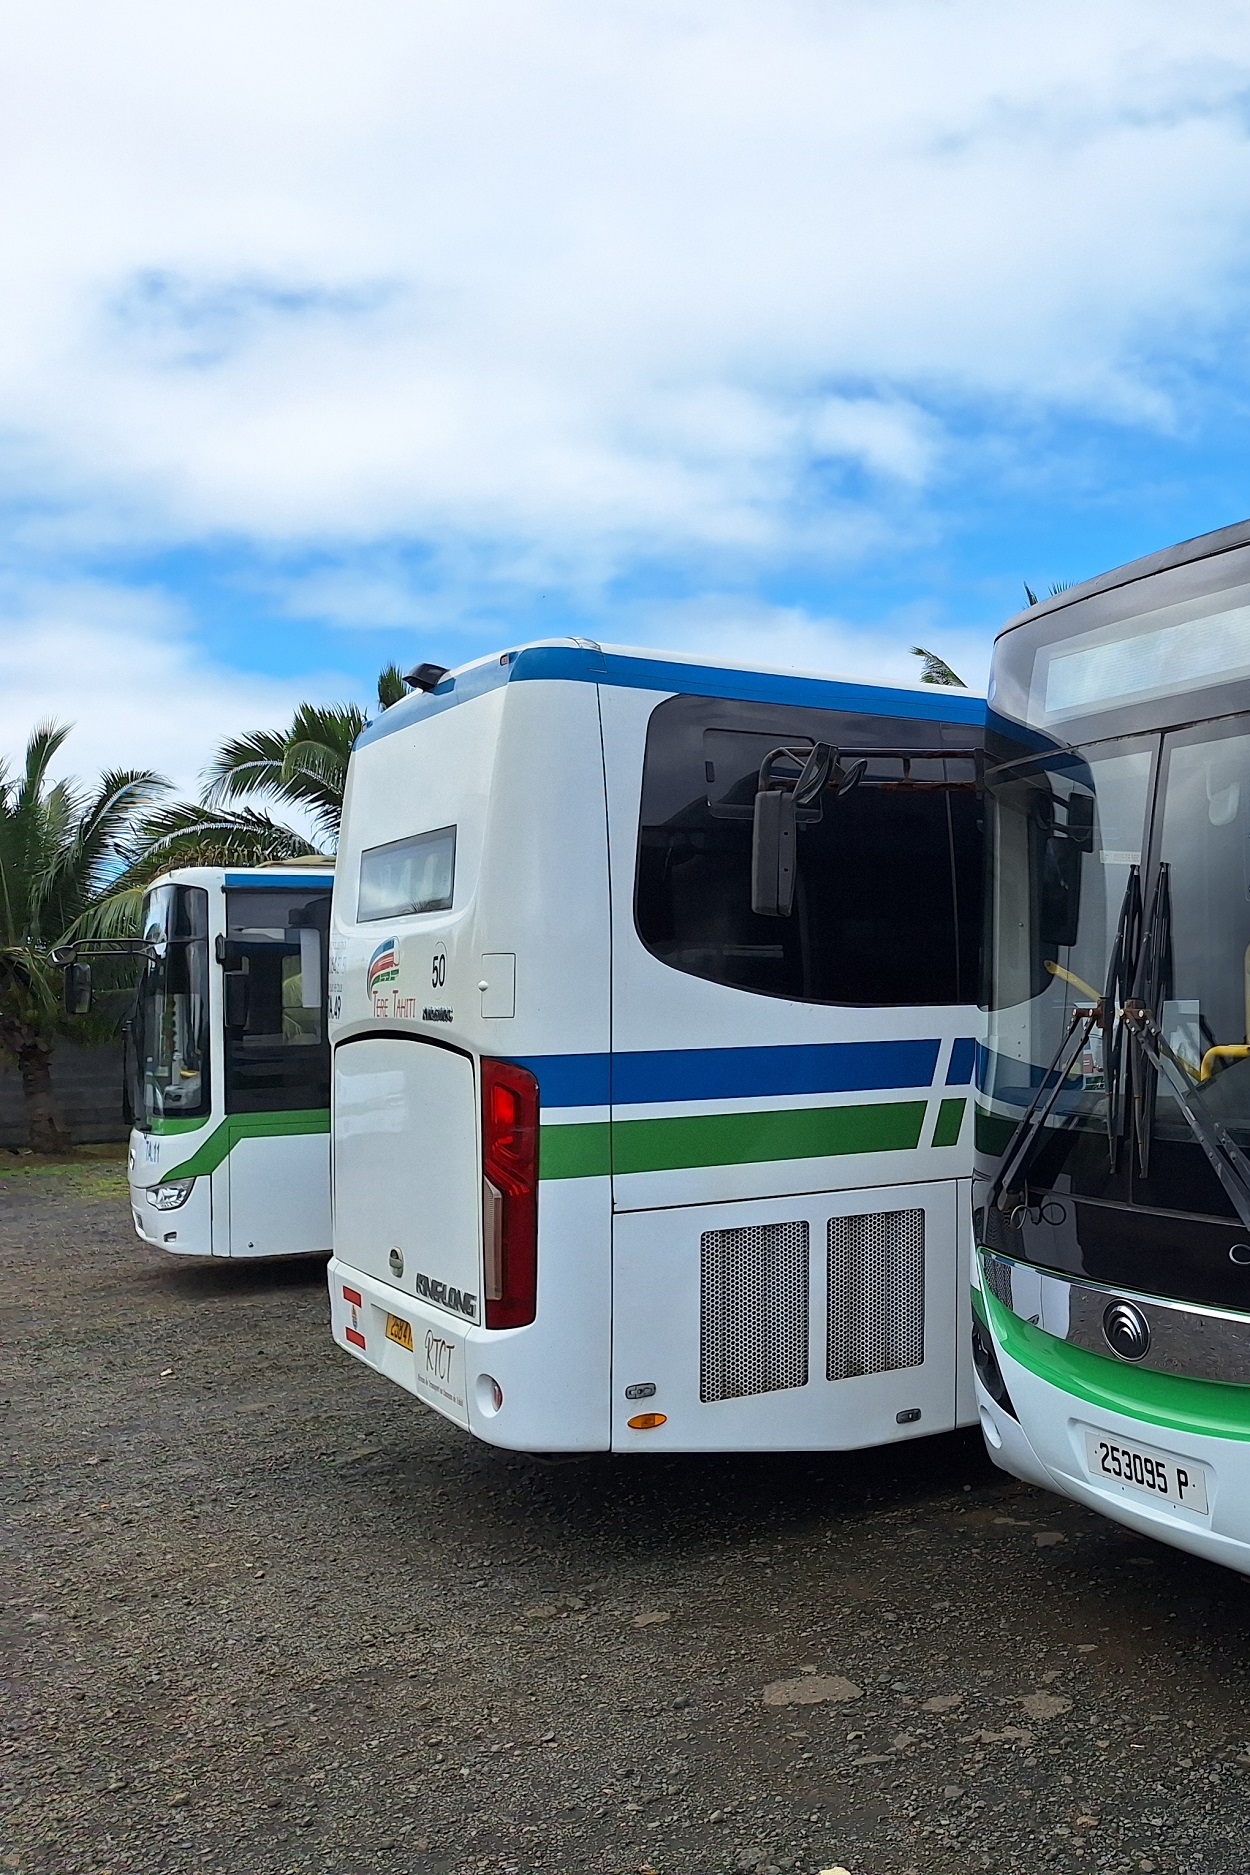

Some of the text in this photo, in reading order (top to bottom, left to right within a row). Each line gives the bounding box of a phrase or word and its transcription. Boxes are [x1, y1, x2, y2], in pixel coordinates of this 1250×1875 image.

[432, 954, 446, 988] 50
[373, 991, 388, 1018] TERE
[392, 990, 416, 1018] TAHITI
[424, 1329, 456, 1383] RTCT
[1099, 1442, 1190, 1500] 253095 P
